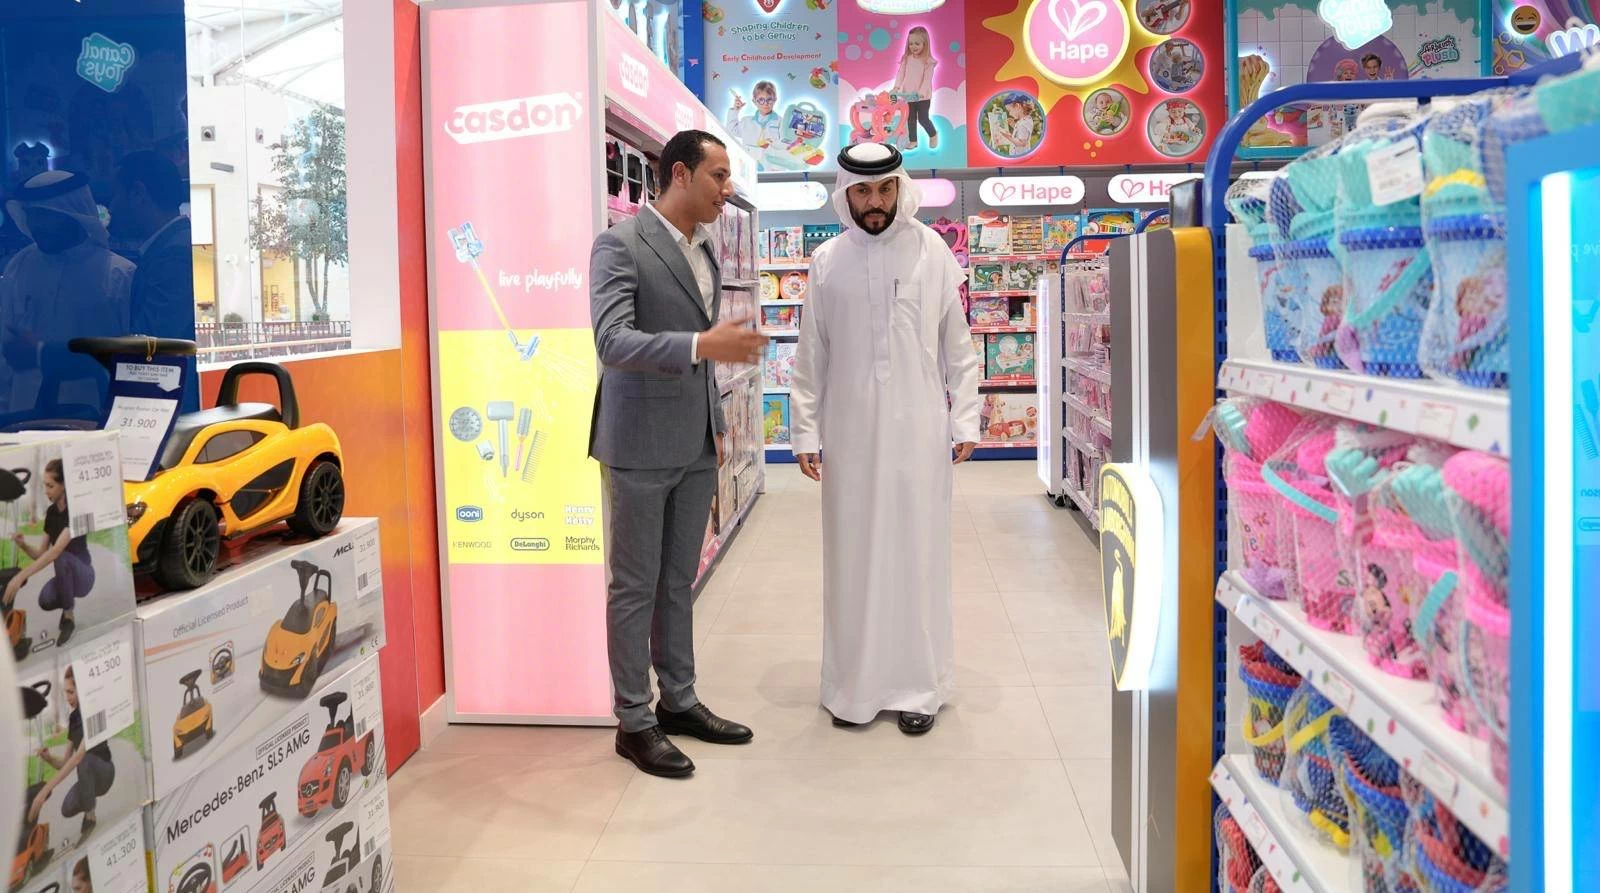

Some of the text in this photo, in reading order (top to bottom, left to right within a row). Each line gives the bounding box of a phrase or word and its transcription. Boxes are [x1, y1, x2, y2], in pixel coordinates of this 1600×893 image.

[731, 21, 810, 35] Shaping Children
[767, 32, 796, 40] Genius
[722, 54, 739, 62] Early
[776, 52, 822, 60] Development
[1049, 41, 1110, 64] Hape
[447, 100, 577, 135] casdon
[1021, 183, 1073, 203] Hape
[1148, 180, 1171, 197] Ha
[499, 267, 583, 293] live playfully
[120, 417, 157, 429] 31.900
[78, 465, 112, 481] 41.300
[459, 510, 481, 518] ooni
[511, 509, 545, 522] dyson
[514, 540, 547, 549] DeLonghi
[565, 536, 595, 545] Morphy
[565, 543, 600, 551] Richards
[333, 543, 354, 559] McL
[172, 596, 249, 638] Official Licensed Product
[88, 656, 121, 679] 41.300
[167, 763, 265, 844] Mercedes-Benz
[267, 747, 284, 770] SLS
[286, 729, 310, 759] AMG
[105, 838, 137, 868] 41.300
[291, 867, 316, 893] AMG
